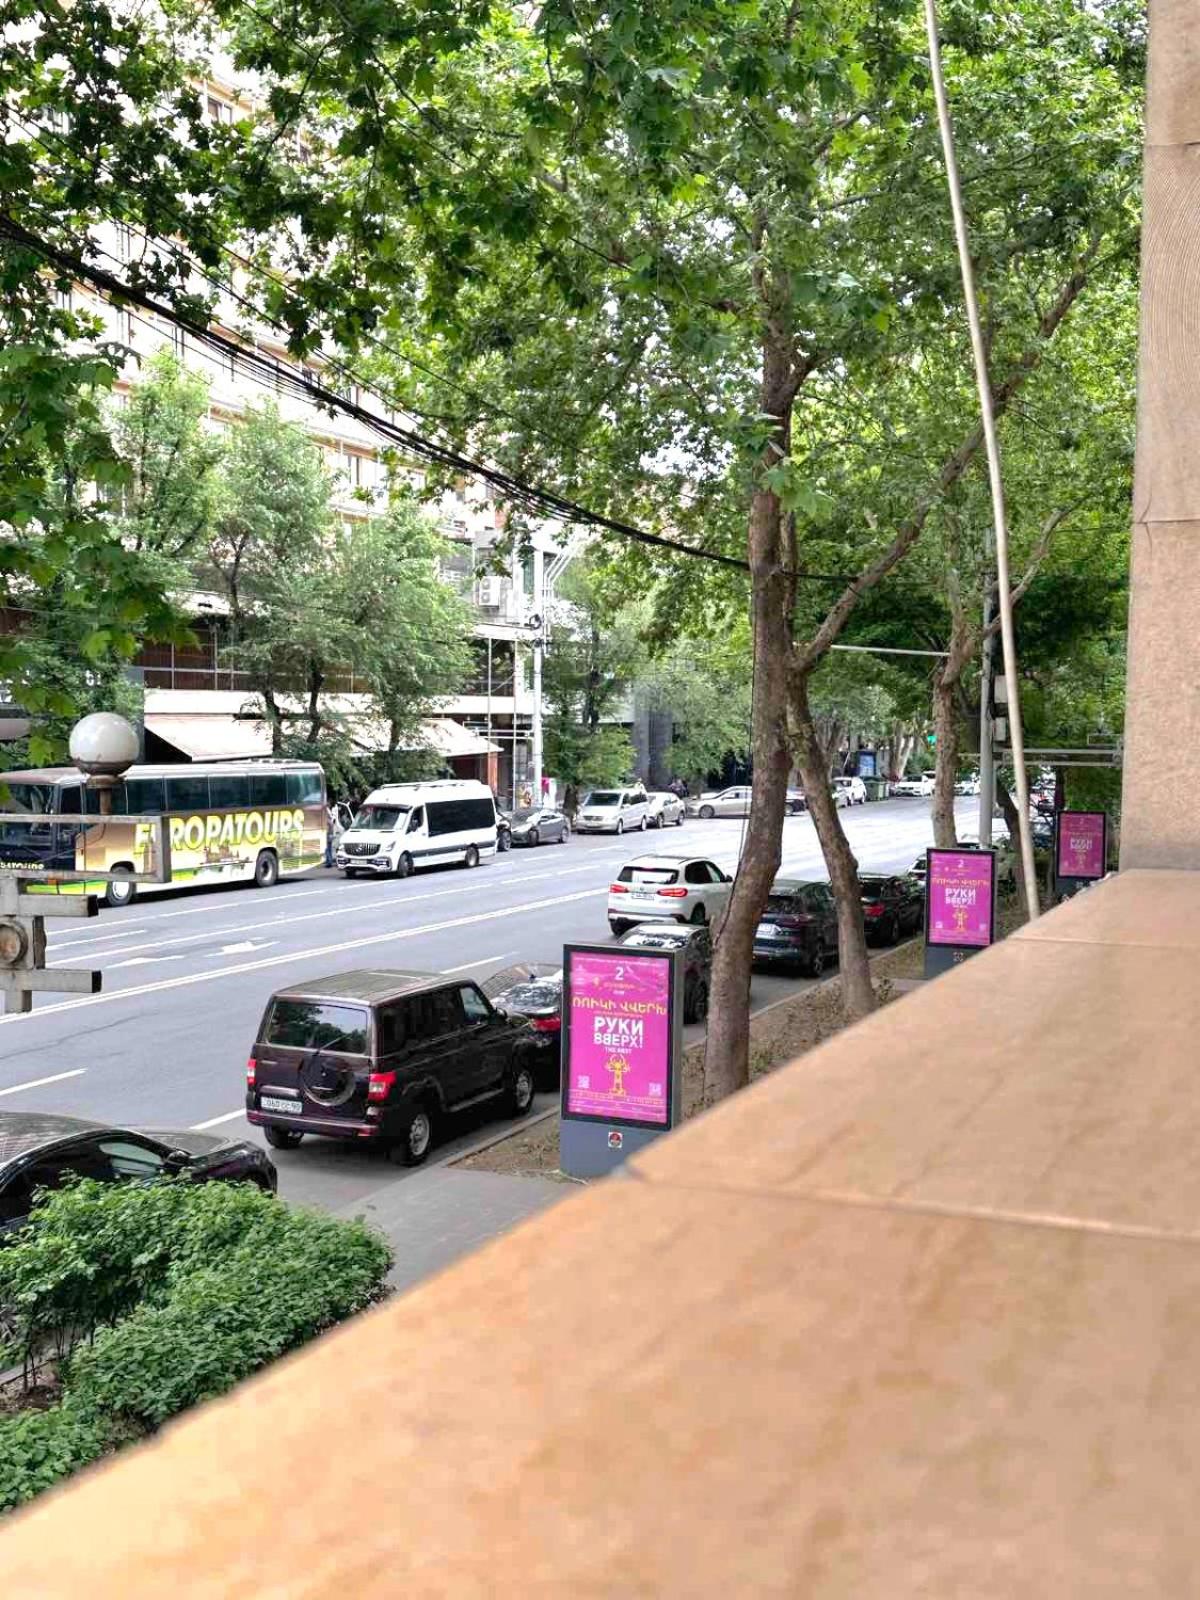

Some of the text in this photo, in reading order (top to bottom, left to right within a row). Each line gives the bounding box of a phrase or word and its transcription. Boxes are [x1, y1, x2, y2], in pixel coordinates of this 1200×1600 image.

[945, 887, 976, 899] РУКИ
[615, 966, 624, 981] 2
[593, 1016, 644, 1036] РУКИ
[593, 1033, 644, 1049] ВВЕРХ!
